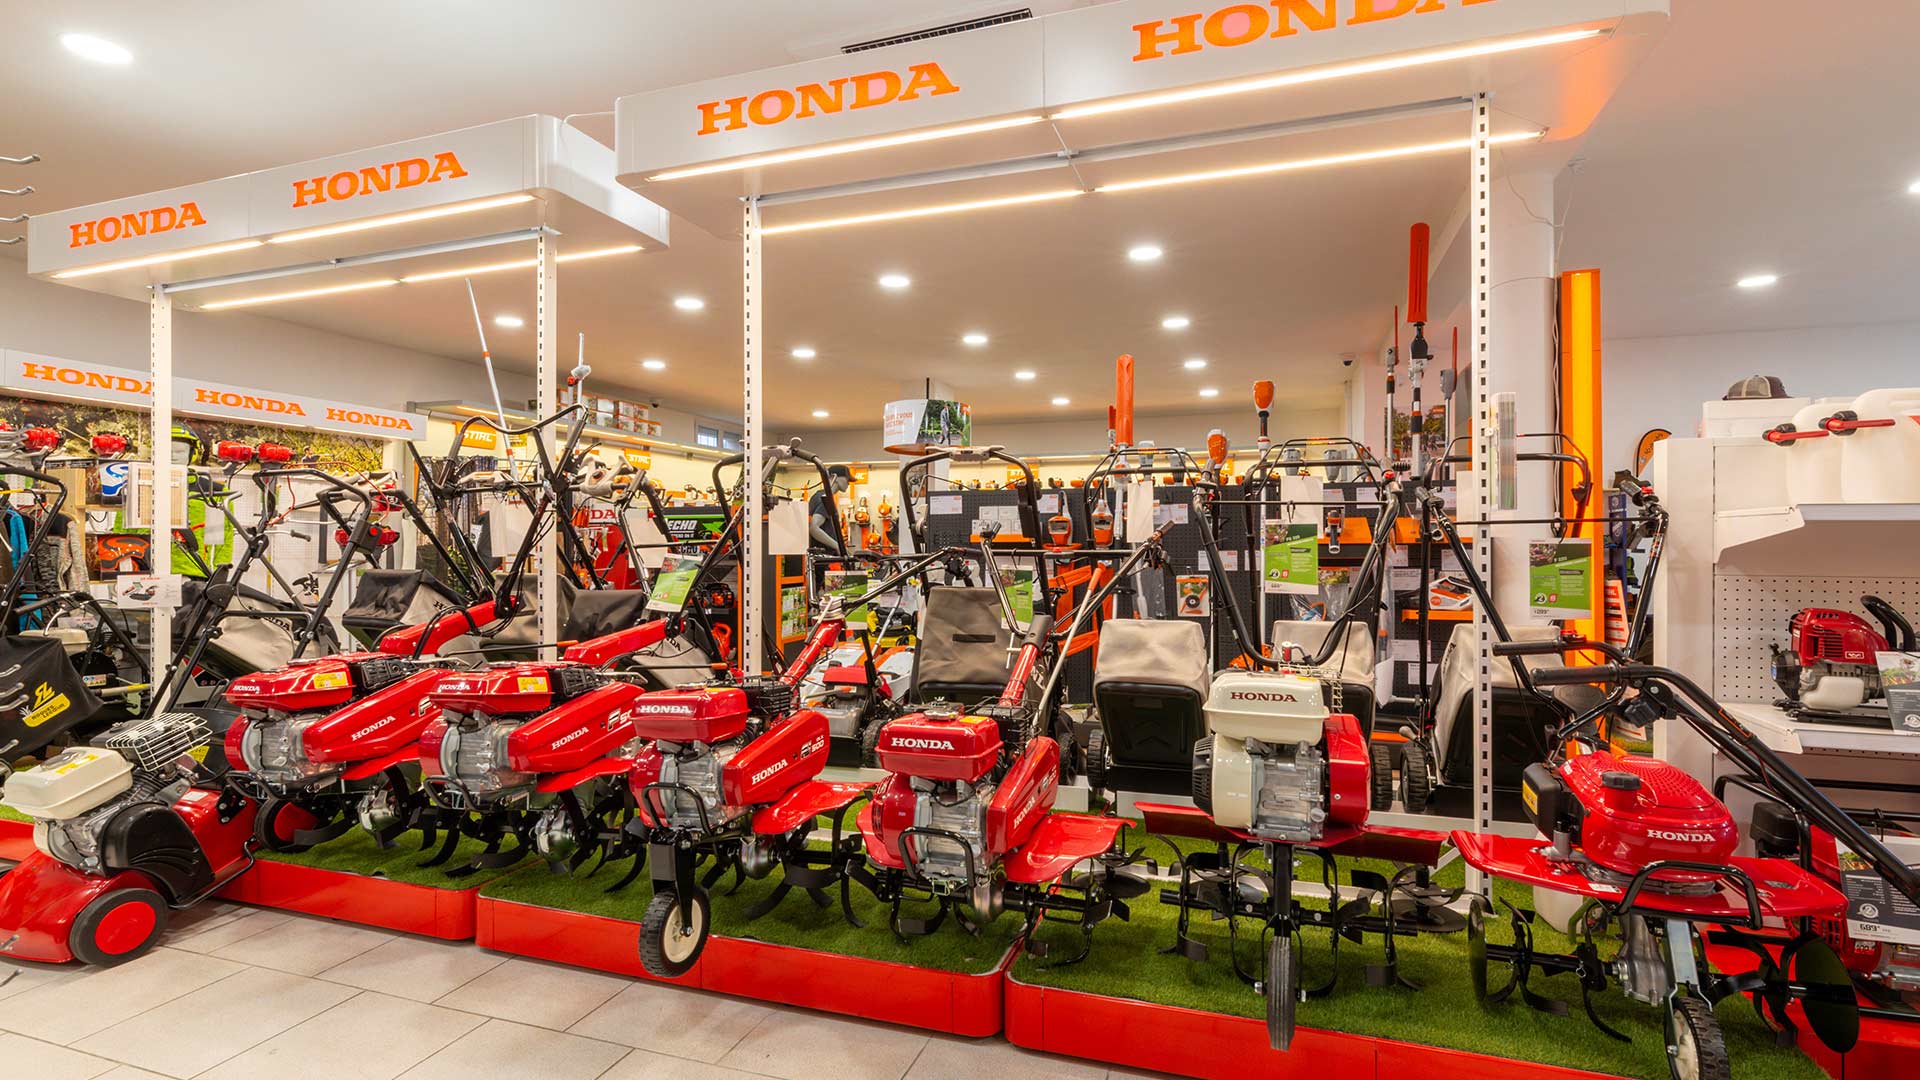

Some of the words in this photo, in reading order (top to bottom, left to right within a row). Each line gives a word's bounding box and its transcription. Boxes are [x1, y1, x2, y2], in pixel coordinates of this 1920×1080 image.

[697, 62, 960, 136] HONDA
[292, 151, 468, 208] HONDA
[69, 202, 206, 248] HONDA
[195, 388, 306, 416] HONDA
[326, 407, 413, 431] HONDA
[668, 520, 698, 530] ECHO
[232, 684, 261, 693] HONDA
[438, 684, 471, 692] HONDA
[1231, 692, 1298, 702] HONDA
[639, 704, 693, 714] HONDA
[351, 715, 396, 741] HONDA
[551, 726, 590, 750] HONDA
[891, 737, 955, 750] HONDA
[751, 758, 788, 785] HONDA
[1013, 796, 1036, 829] HONDA
[1647, 829, 1716, 842] HONDA
